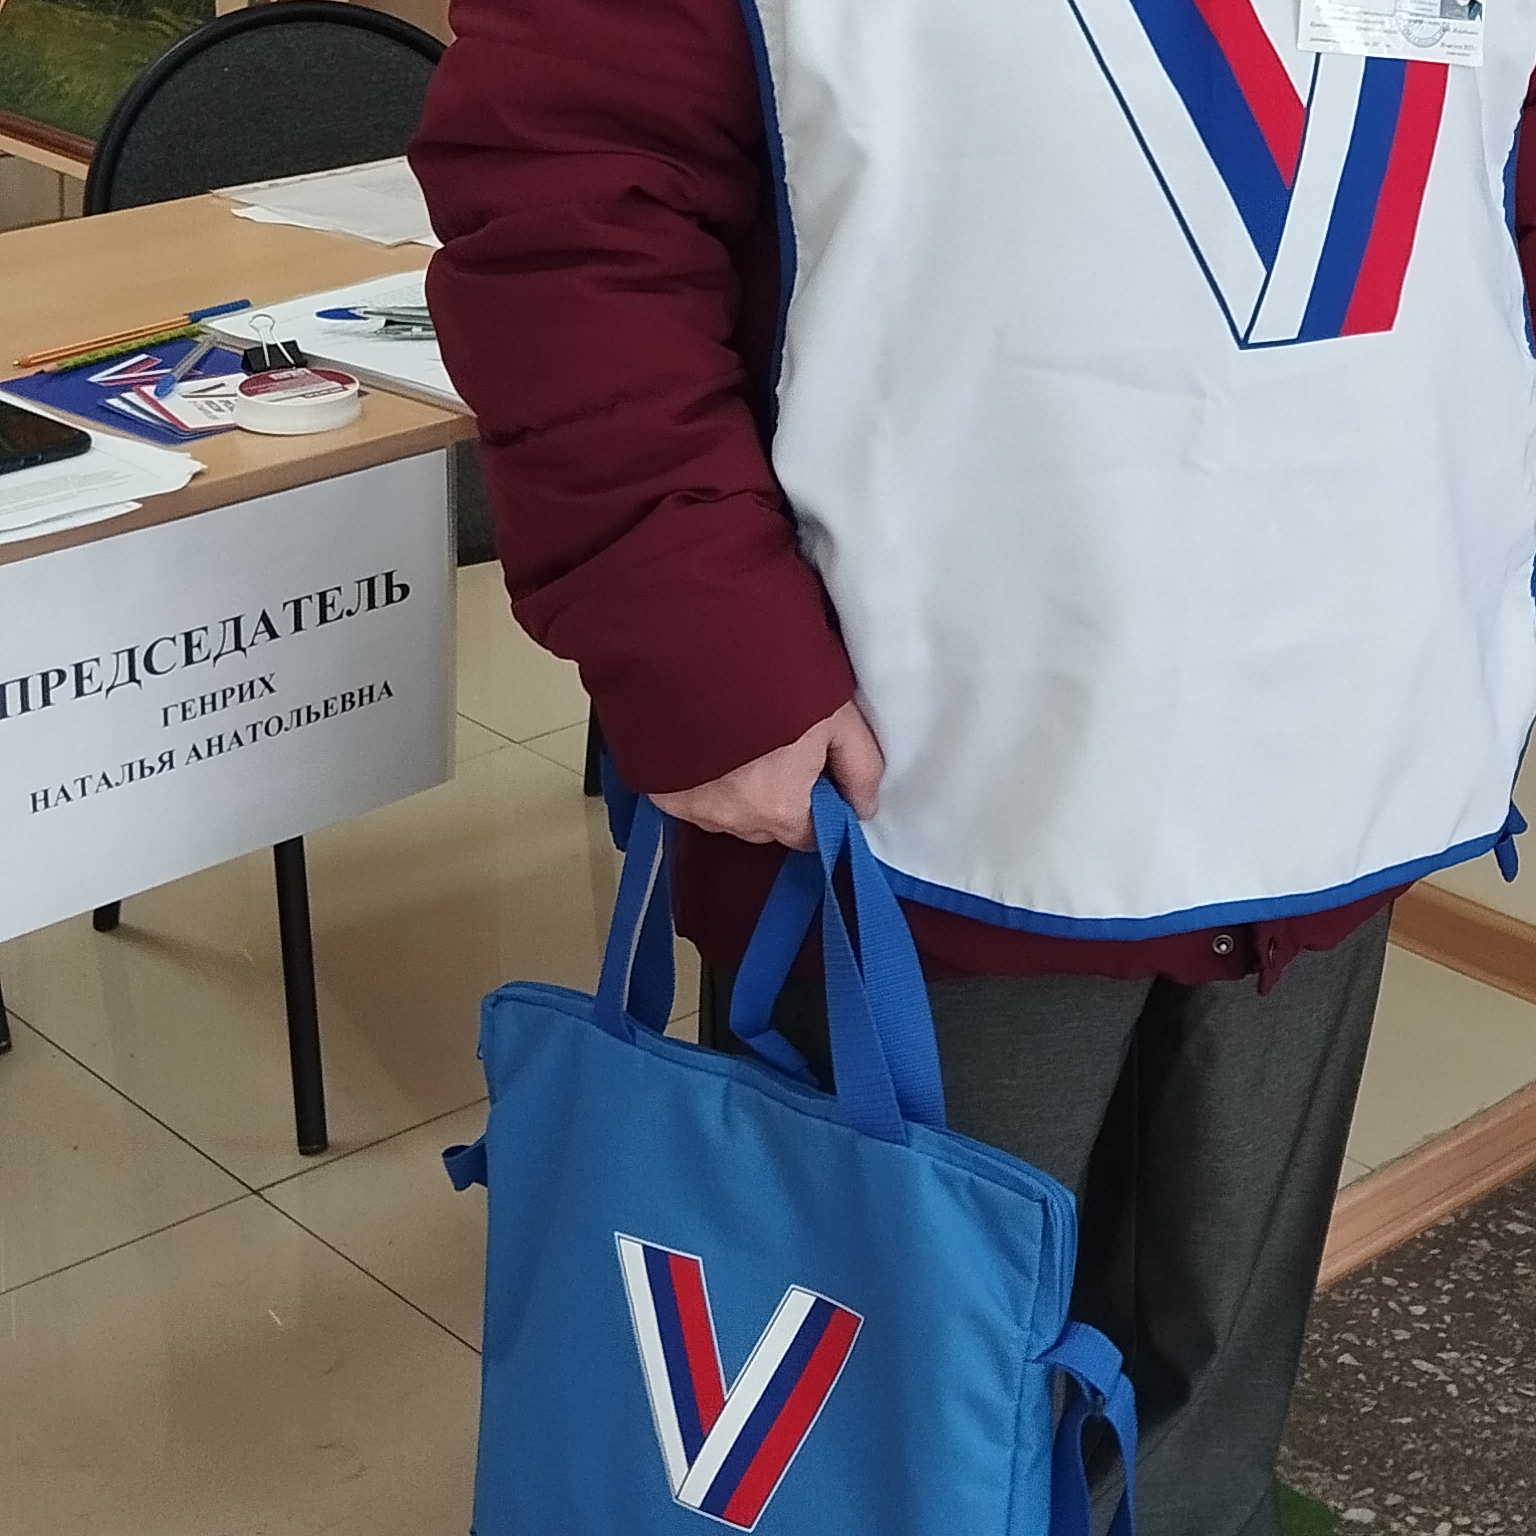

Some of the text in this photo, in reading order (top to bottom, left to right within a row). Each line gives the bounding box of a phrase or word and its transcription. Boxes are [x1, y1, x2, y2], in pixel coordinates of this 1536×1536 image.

[0, 570, 411, 721] ПРЕДСЕДАТЕЛЬ
[161, 673, 278, 728] ГЕНРИХ
[30, 680, 394, 814] НАТАЛЬЯ АНАТОЛЬЕВНА
